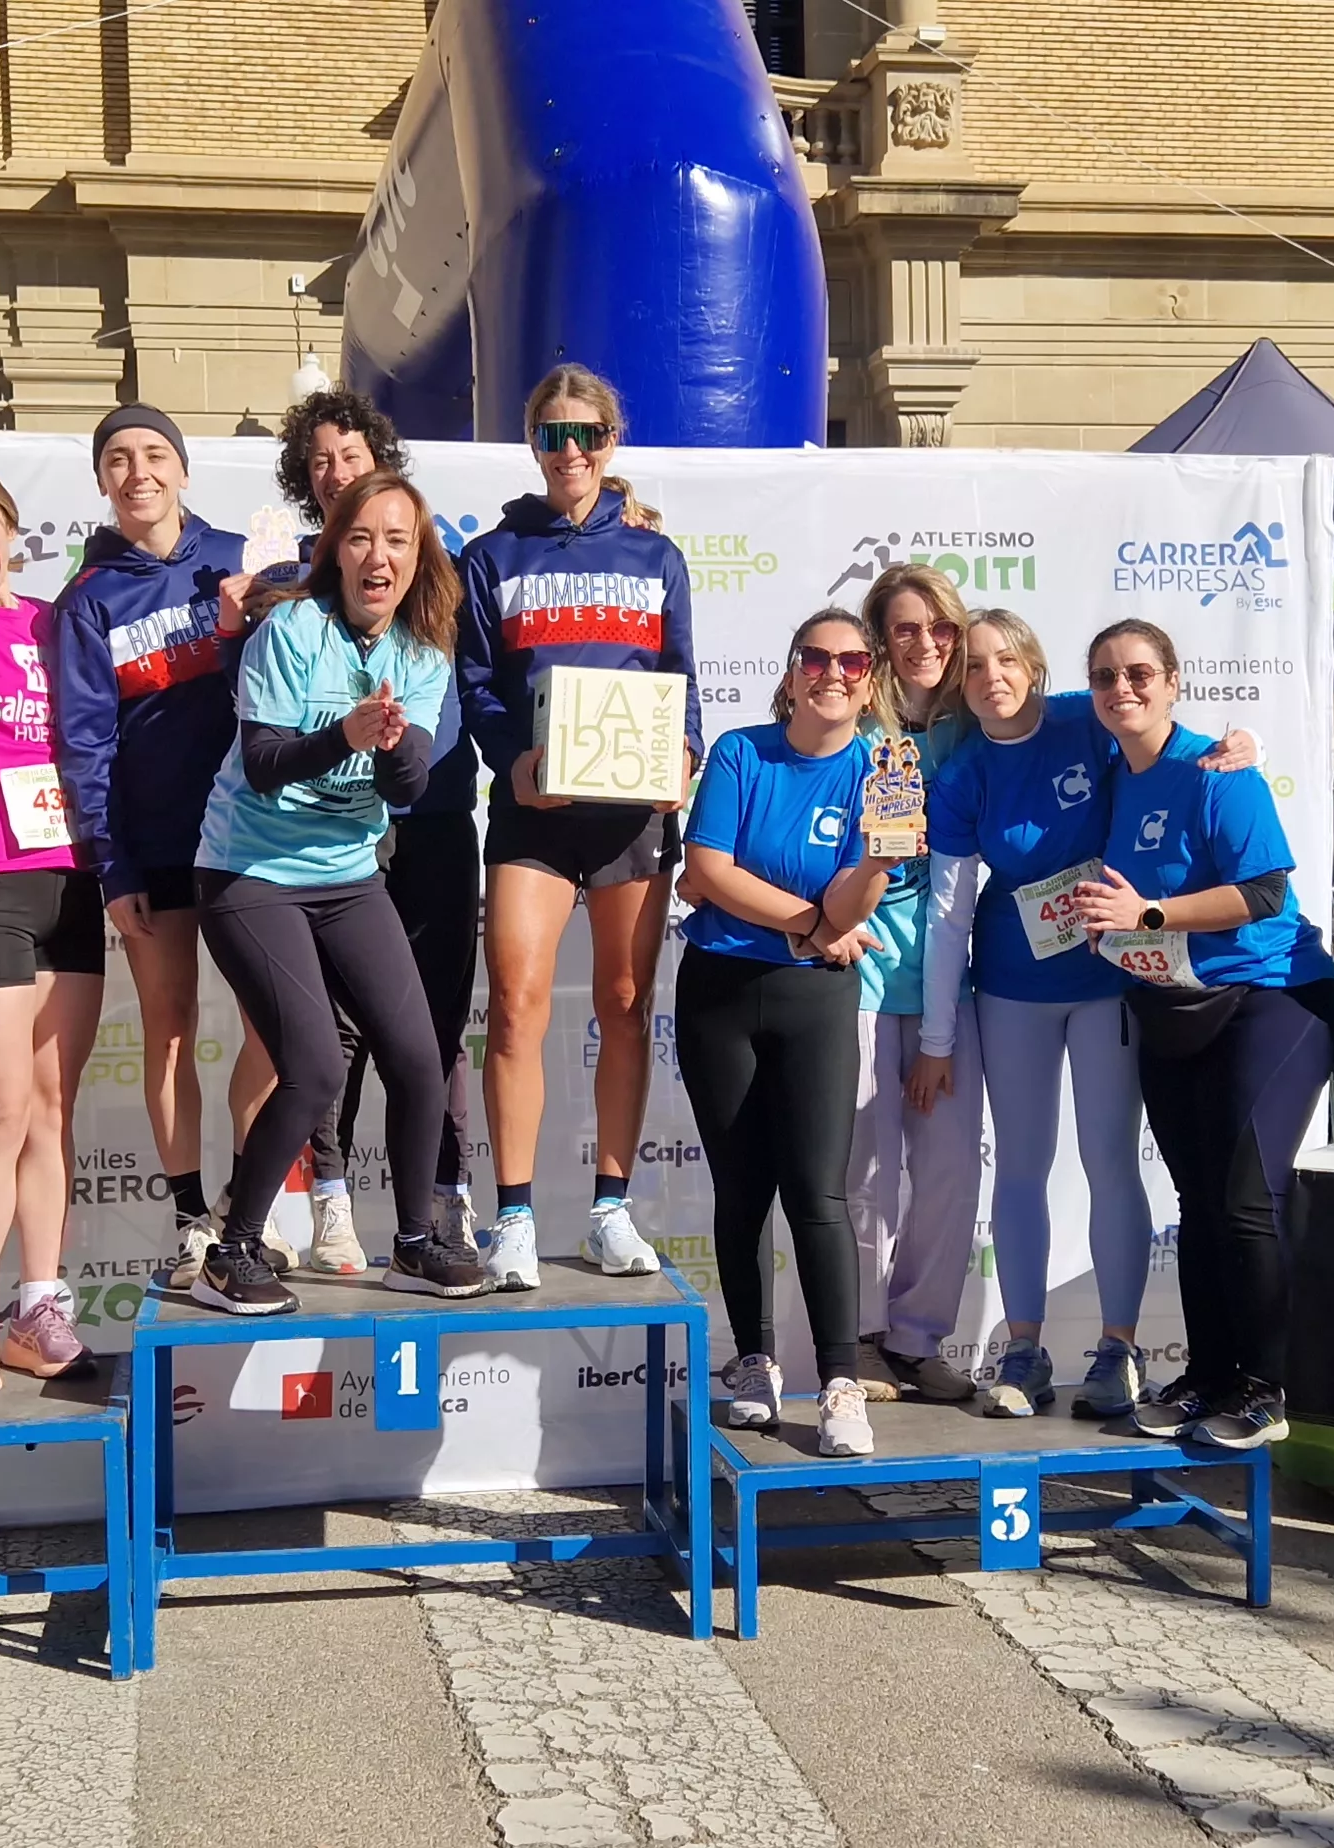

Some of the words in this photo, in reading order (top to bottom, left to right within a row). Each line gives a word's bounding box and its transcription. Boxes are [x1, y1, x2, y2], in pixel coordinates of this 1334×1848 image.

[910, 531, 1035, 547] ATLETISMO
[1117, 541, 1261, 566] CARRERA
[520, 572, 650, 611] BOMBEROS
[1114, 568, 1266, 592] EMPRESAS
[1236, 597, 1251, 611] By
[126, 600, 221, 658] BOMBER
[521, 606, 649, 628] HUESCA
[137, 636, 221, 672] HUES
[558, 723, 646, 791] 125
[649, 705, 672, 792] AMBAR
[33, 787, 68, 812] 43
[875, 795, 923, 816] EMPRESAS
[873, 837, 882, 855] 3
[1055, 913, 1086, 933] LIDI
[1057, 931, 1078, 945] 8K
[1120, 950, 1169, 972] 433
[391, 1341, 419, 1396] 1
[339, 1398, 368, 1418] de
[990, 1488, 1030, 1542] 3
